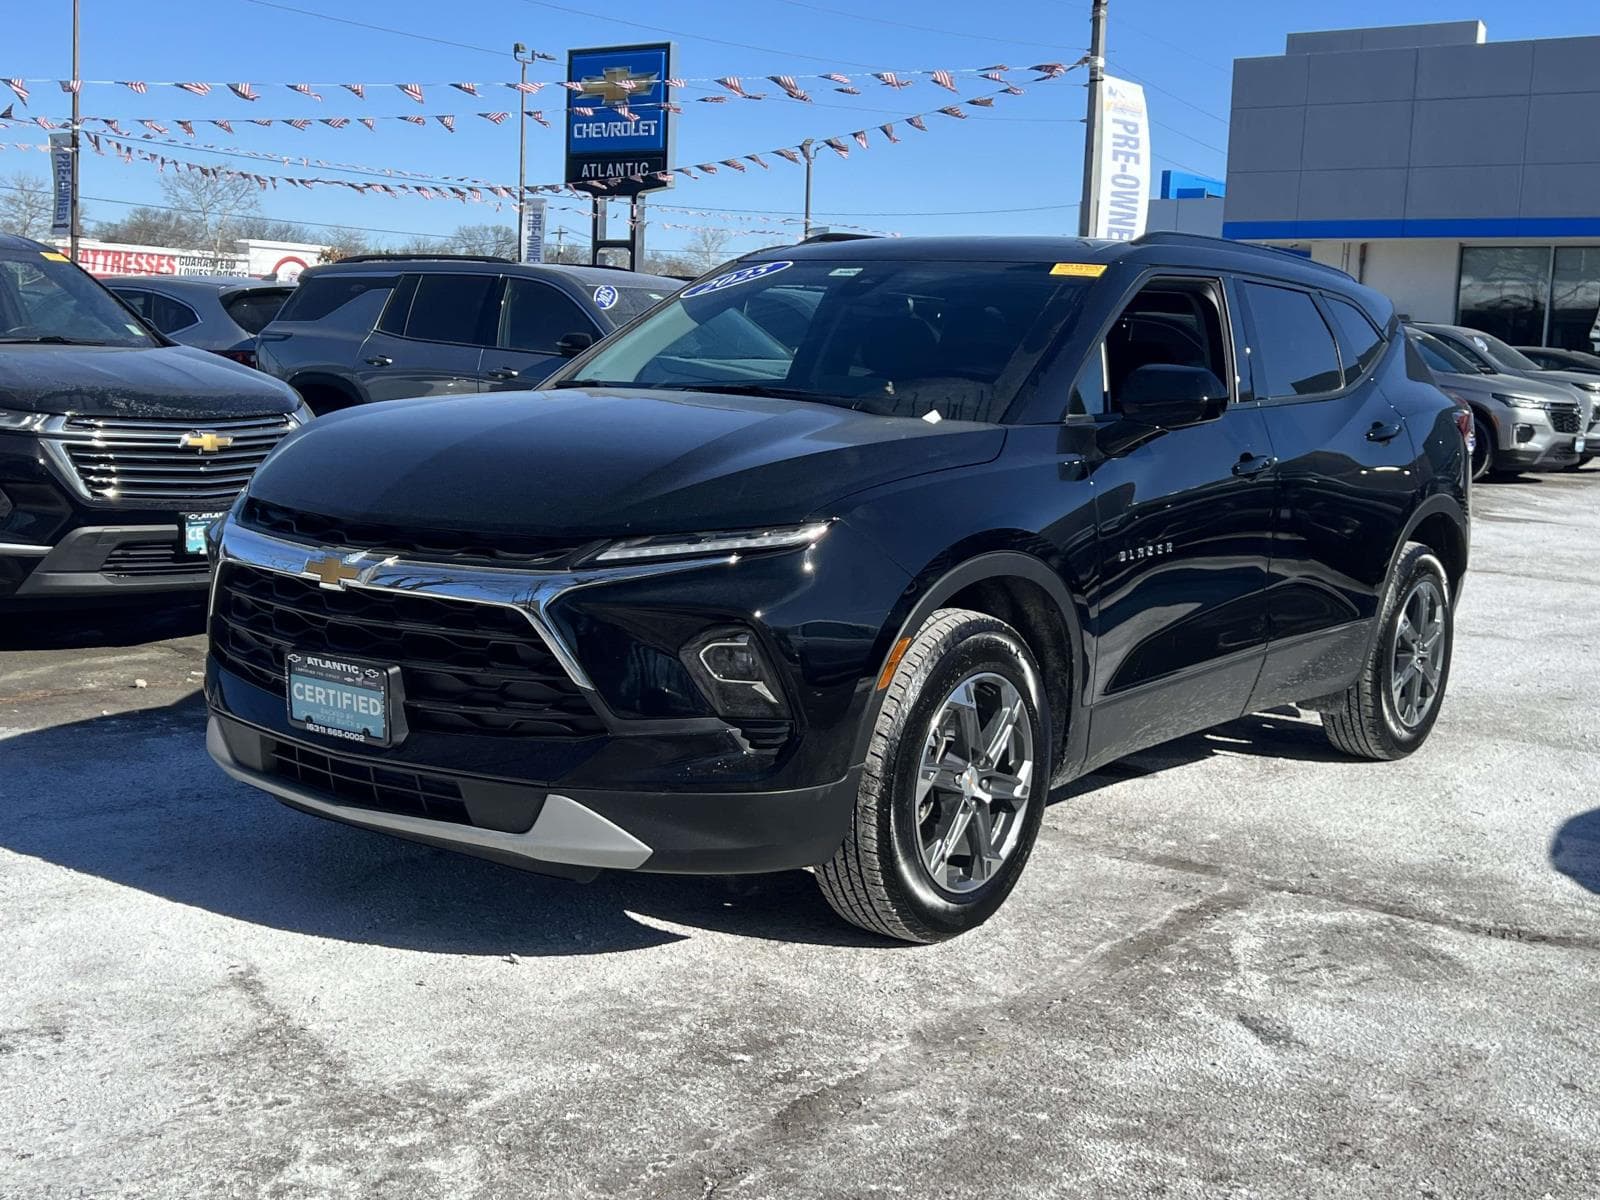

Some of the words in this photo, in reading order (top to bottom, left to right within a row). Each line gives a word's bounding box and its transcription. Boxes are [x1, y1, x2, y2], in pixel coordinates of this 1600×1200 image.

[573, 120, 658, 139] CHEVROLET
[581, 162, 649, 178] ATLANTIC
[1119, 542, 1173, 562] BLAZER
[307, 656, 360, 675] ATLANTIC
[293, 682, 382, 716] CERTIFIED
